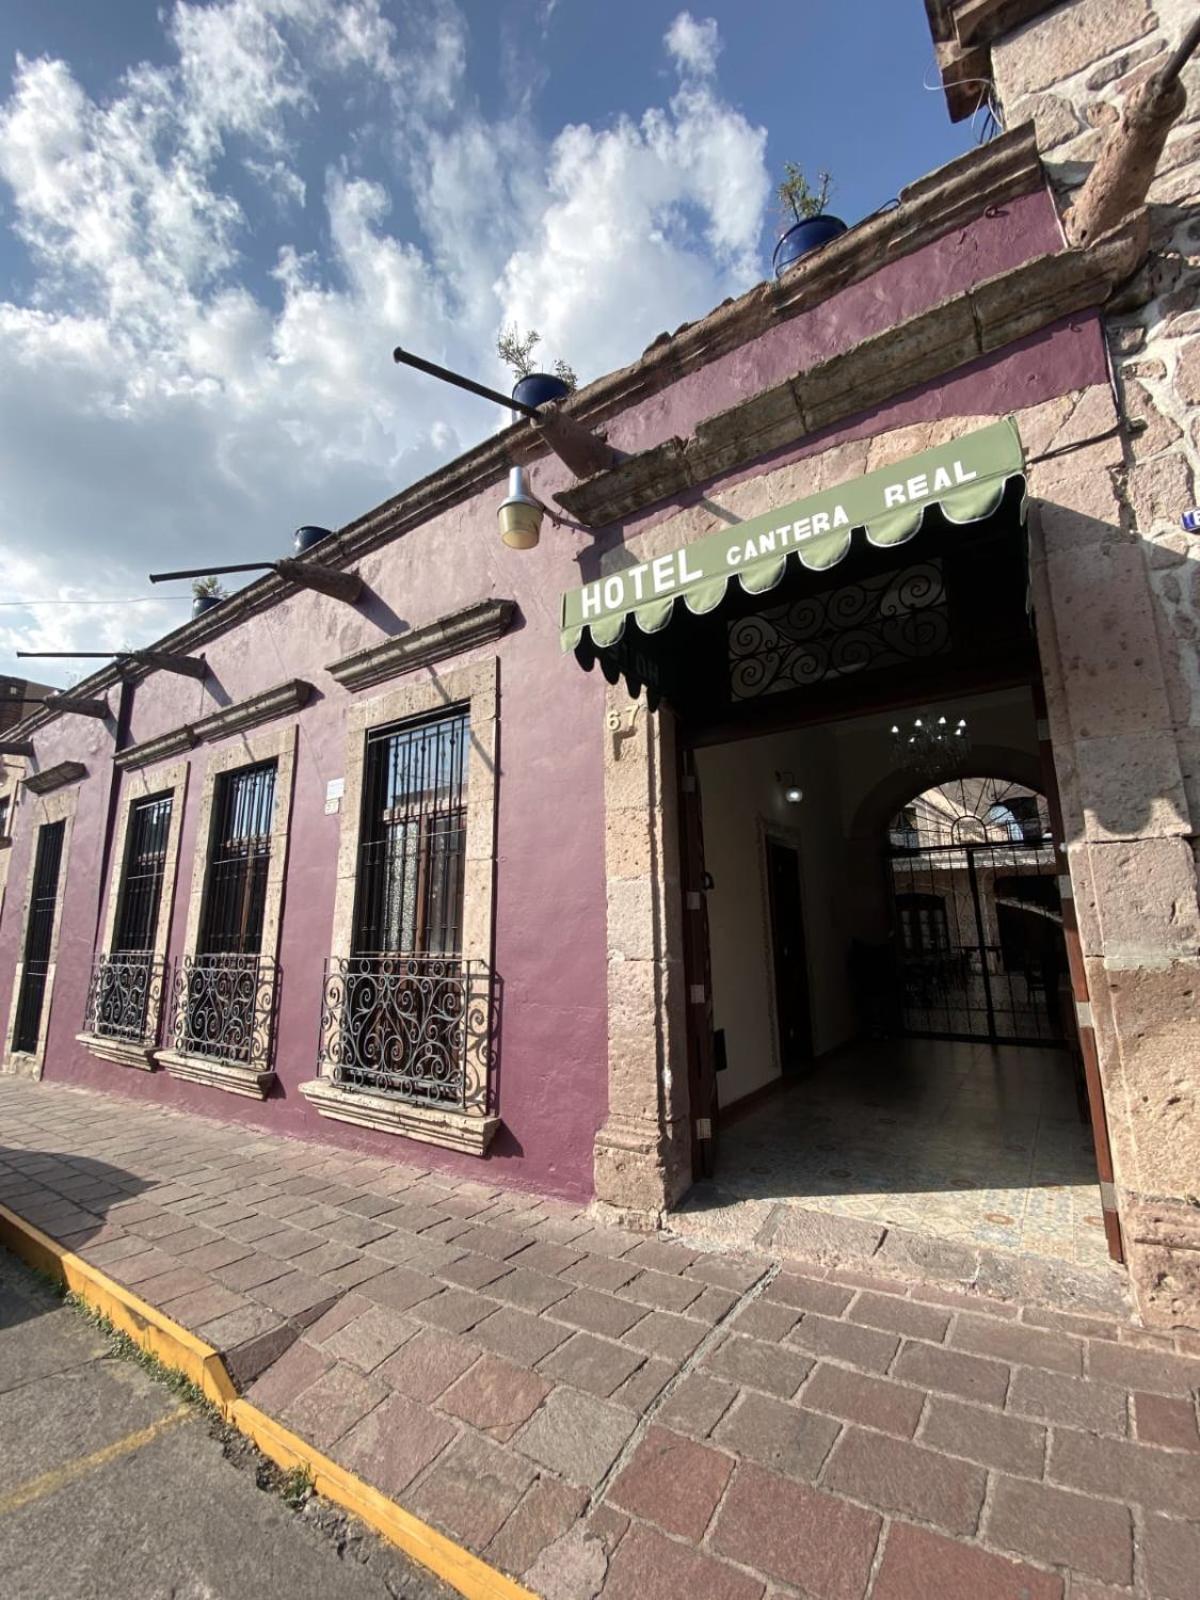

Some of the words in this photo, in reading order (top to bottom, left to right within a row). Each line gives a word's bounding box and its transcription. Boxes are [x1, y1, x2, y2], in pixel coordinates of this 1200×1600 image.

[581, 549, 703, 619] HOTEL
[726, 505, 849, 566] CANTERA
[884, 460, 977, 508] REAL
[607, 704, 640, 731] 67
